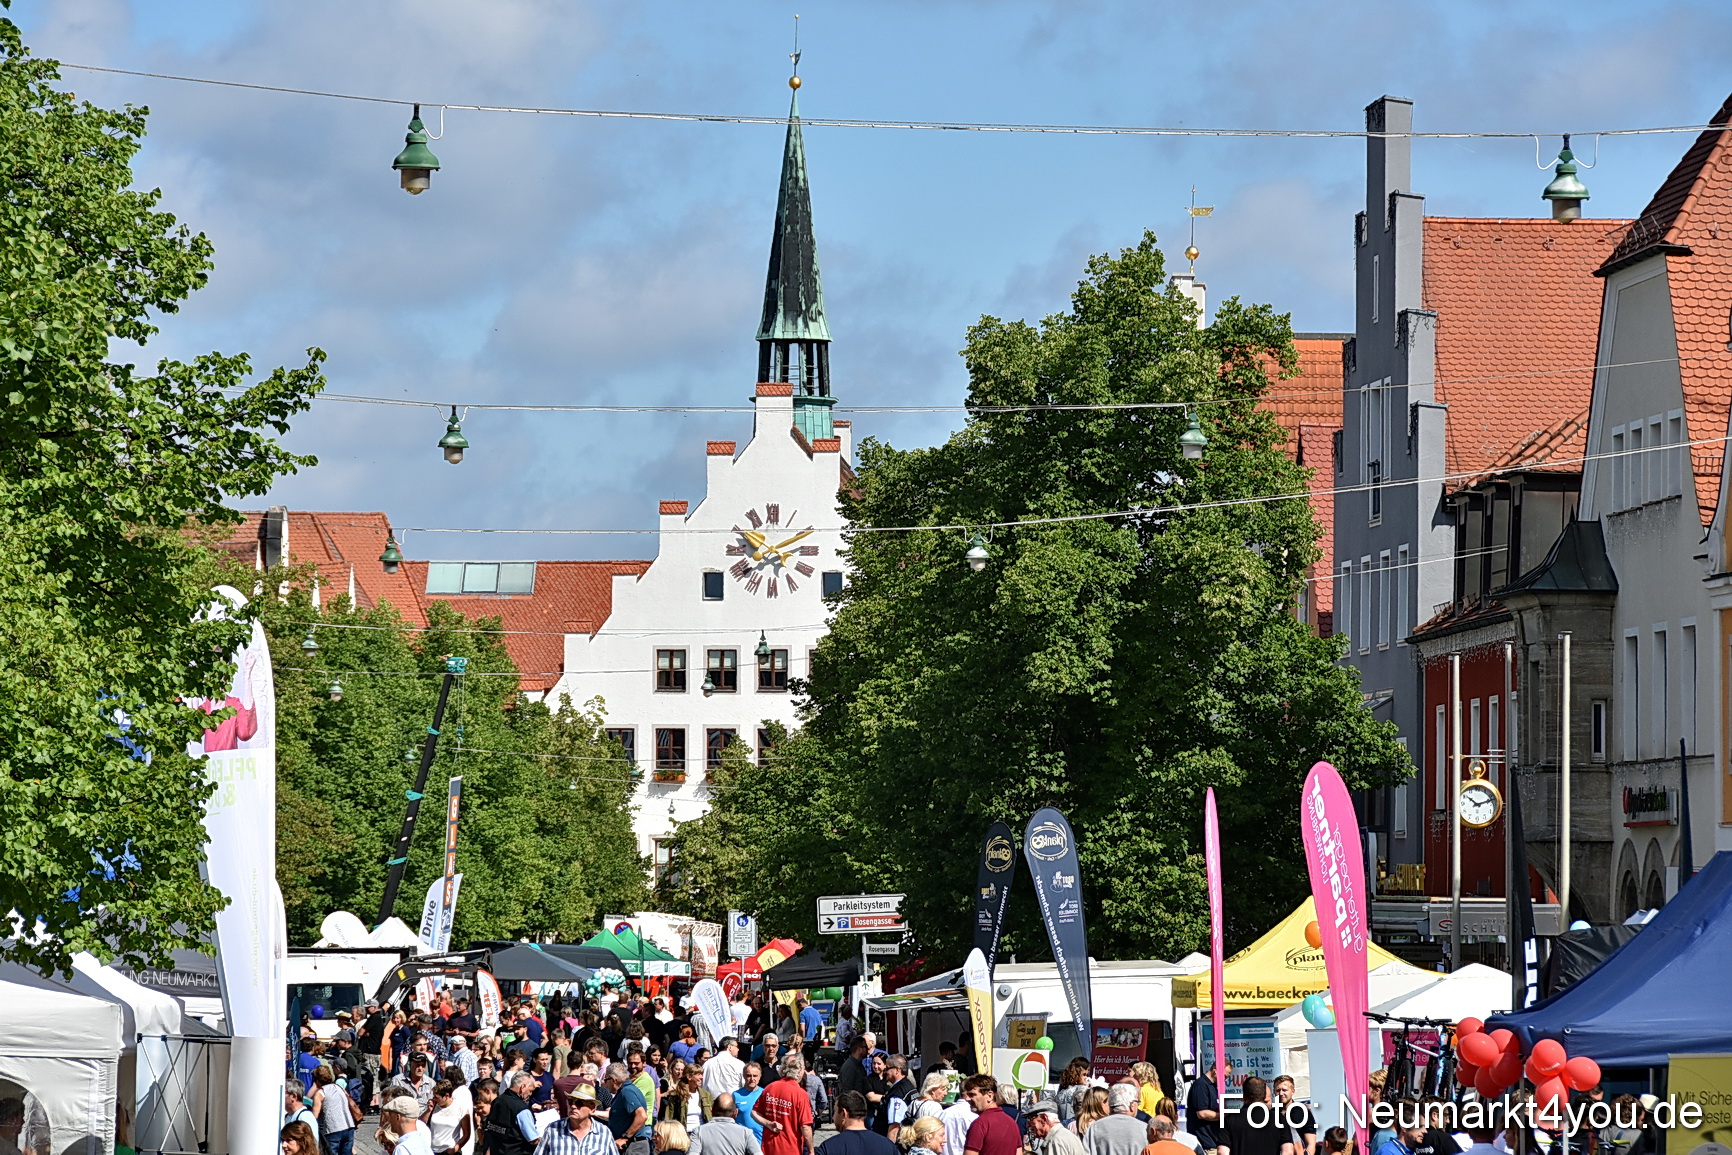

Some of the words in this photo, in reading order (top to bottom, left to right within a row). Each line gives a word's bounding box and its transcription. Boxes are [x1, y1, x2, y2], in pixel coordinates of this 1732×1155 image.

[833, 900, 891, 911] Parkleitsystem
[423, 900, 437, 937] Drive
[855, 918, 892, 926] Rosengasse
[992, 924, 1001, 954] besser
[997, 885, 1009, 924] schmeckt
[1293, 954, 1325, 965] plan
[152, 971, 217, 987] NEUMARKT
[1094, 1055, 1106, 1063] Hier
[1246, 1056, 1260, 1068] ist
[1677, 1091, 1696, 1106] Mit
